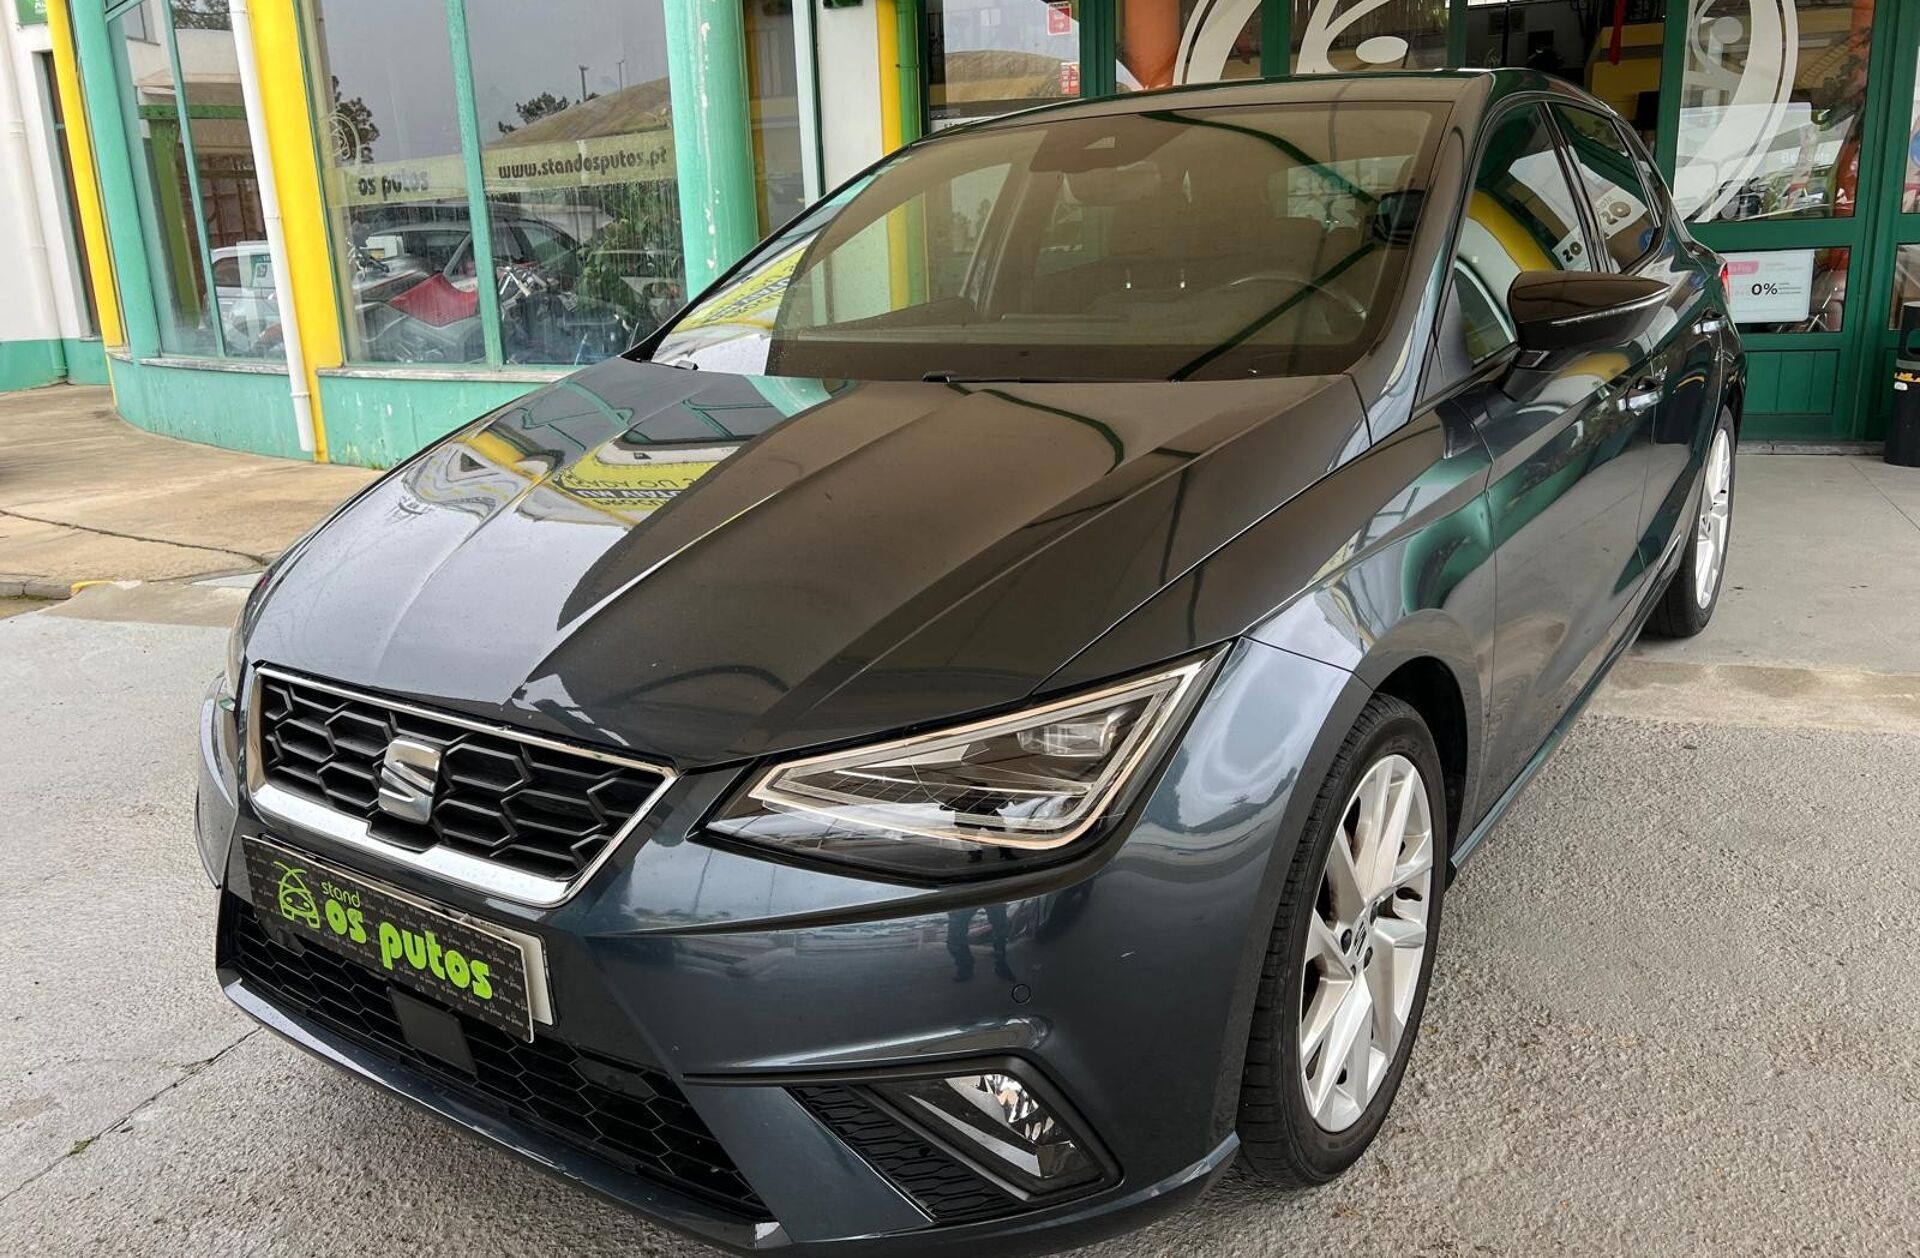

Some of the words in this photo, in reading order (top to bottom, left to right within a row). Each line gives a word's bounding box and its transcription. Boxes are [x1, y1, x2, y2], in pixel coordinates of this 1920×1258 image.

[498, 146, 667, 179] www.standosputos.pt
[358, 177, 377, 196] os
[381, 168, 430, 201] putos
[1751, 282, 1778, 296] 0%
[321, 880, 361, 908] stand
[324, 898, 367, 944] os
[378, 921, 493, 1000] putos
